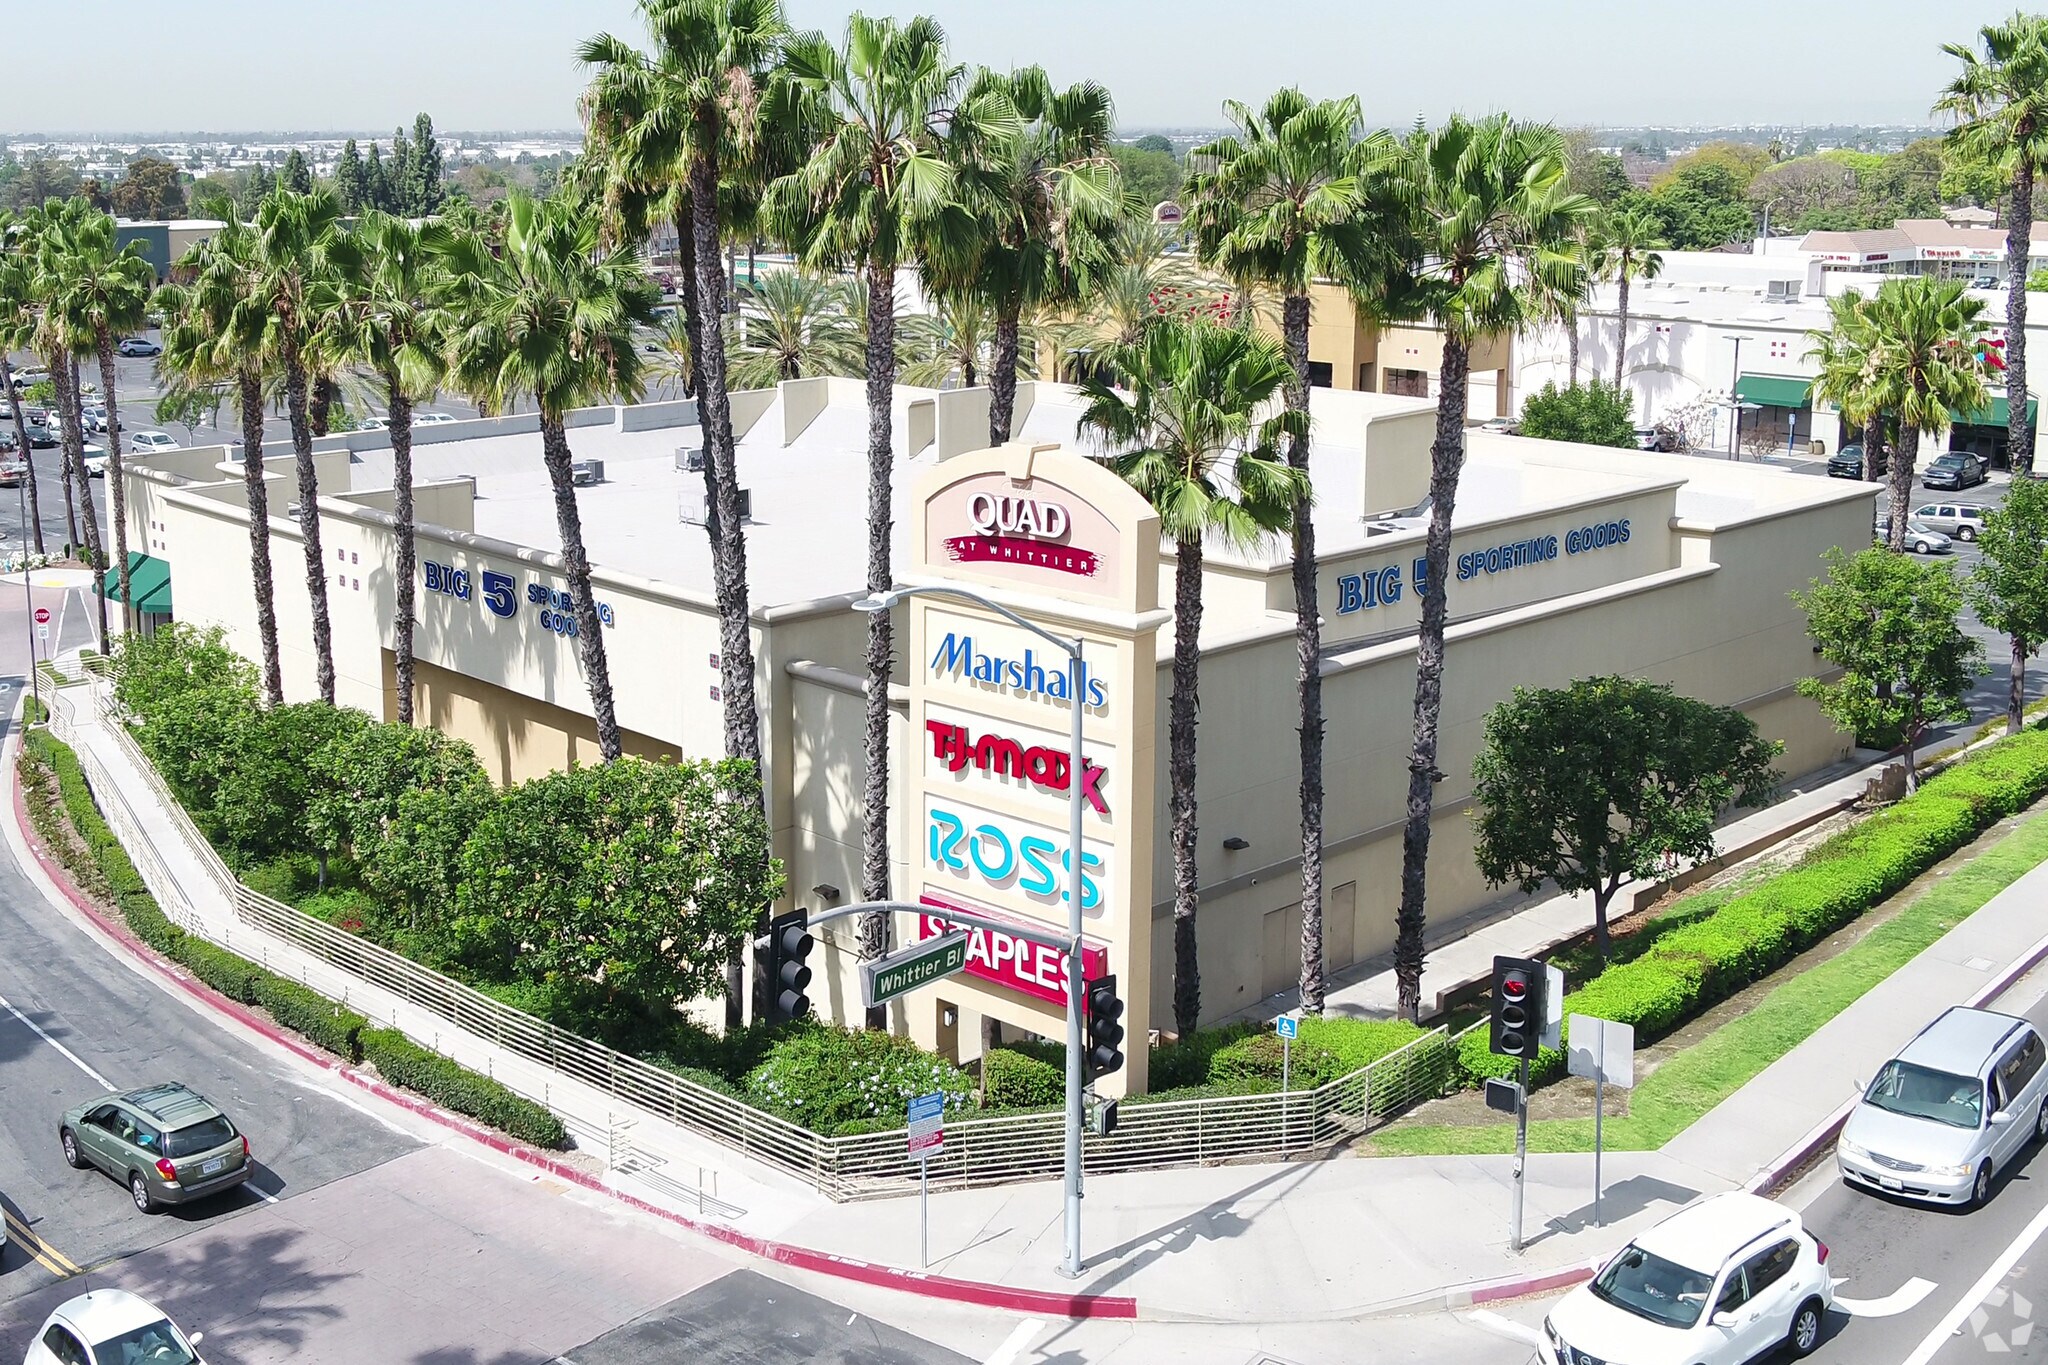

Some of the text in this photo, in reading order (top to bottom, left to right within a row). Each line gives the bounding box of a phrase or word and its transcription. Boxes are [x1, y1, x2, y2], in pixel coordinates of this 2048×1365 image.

[966, 492, 1069, 538] QUAD
[958, 540, 1087, 570] AT WHITTIER
[1337, 565, 1402, 615] BIG
[1457, 535, 1558, 581] SPORTING
[1565, 519, 1631, 555] GOODS
[424, 560, 517, 619] BIG 5
[931, 633, 1103, 706] Marshalls
[930, 809, 1099, 908] ROSS
[881, 947, 961, 994] Whittier Bl
